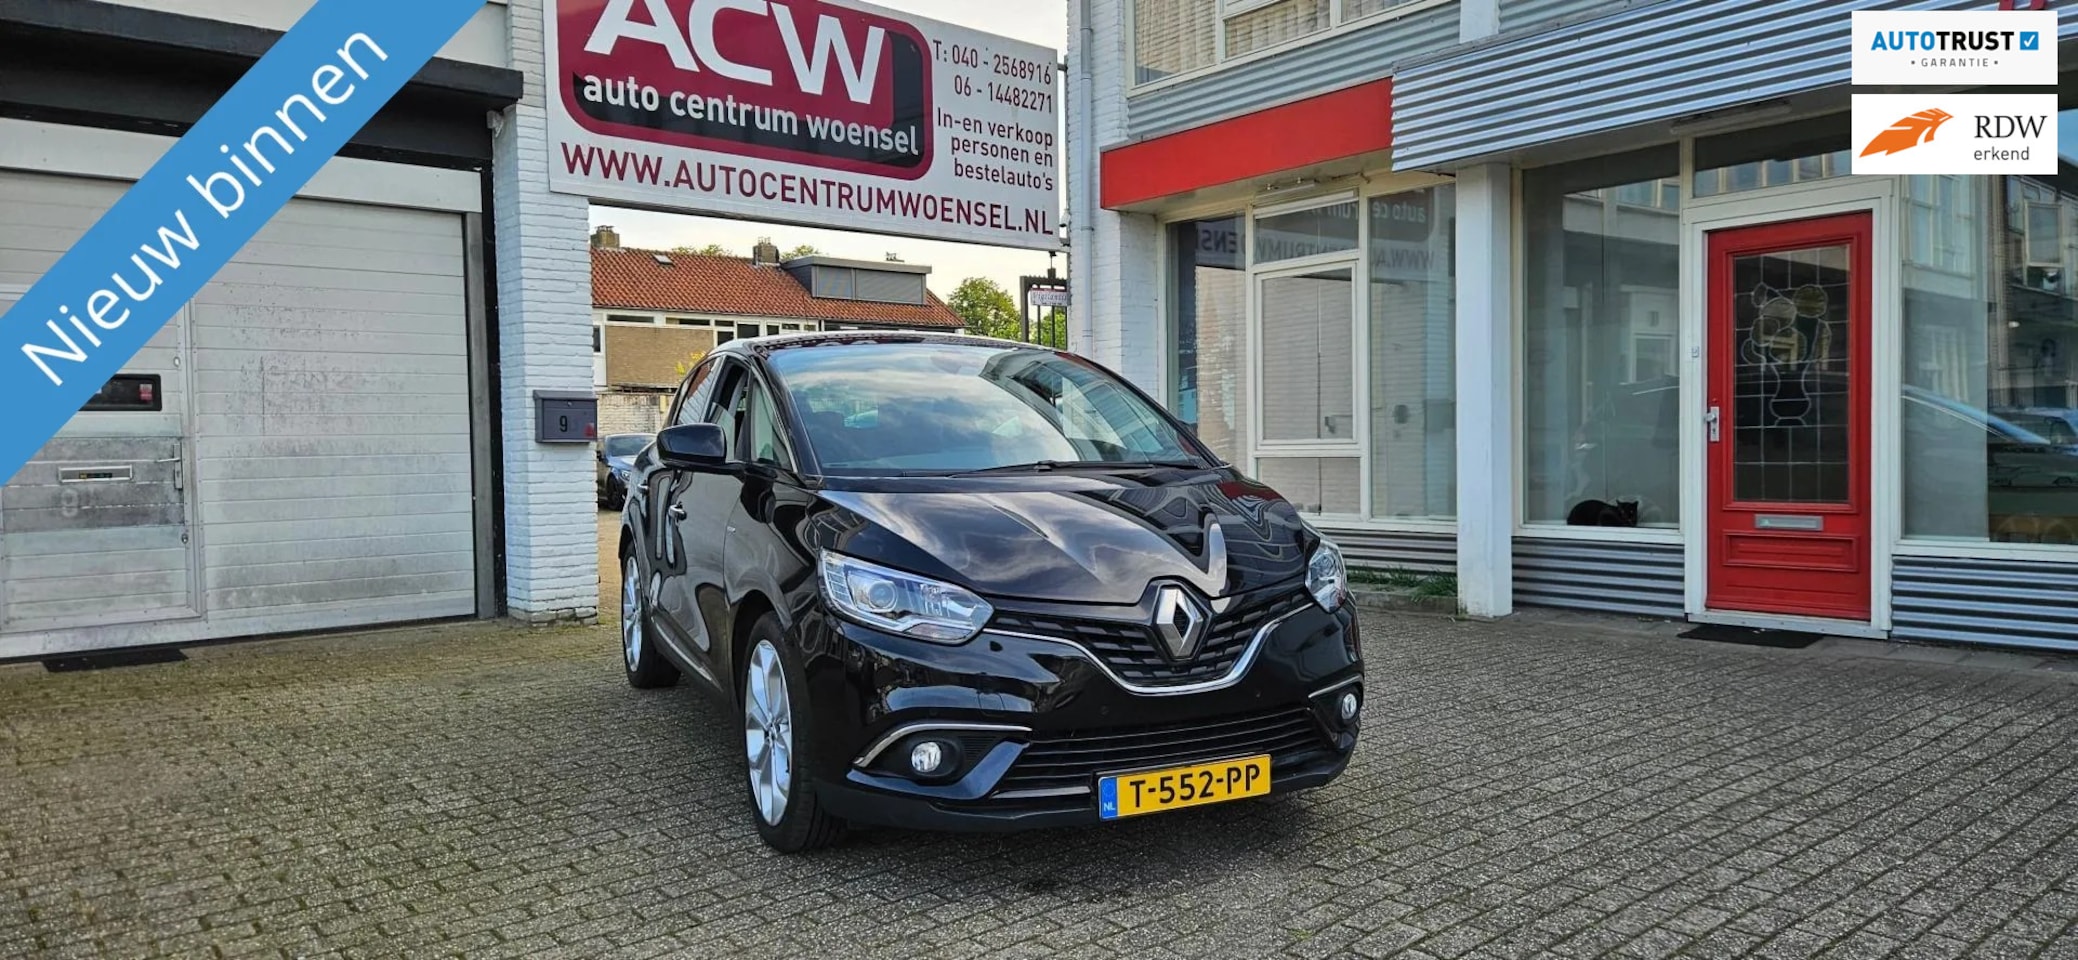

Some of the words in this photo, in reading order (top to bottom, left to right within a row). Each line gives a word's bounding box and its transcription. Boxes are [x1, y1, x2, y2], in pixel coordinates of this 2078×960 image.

[583, 0, 886, 105] ACW
[932, 39, 948, 63] T:
[952, 44, 978, 69] 040
[993, 53, 1052, 85] 2568916
[583, 74, 660, 112] auto
[669, 90, 798, 137] centrum
[805, 114, 919, 156] woensel
[954, 74, 972, 97] 06
[987, 81, 1052, 113] 14482271
[937, 107, 983, 134] In-en
[987, 122, 1053, 151] verkoop
[951, 136, 1029, 163] personen
[1034, 151, 1053, 168] en
[954, 157, 1053, 191] bestelauto's
[560, 141, 1054, 236] WWW.AUTOCENTRUMWOENSEL.NL
[559, 415, 568, 433] 9
[1103, 802, 1116, 811] NL
[1129, 763, 1261, 808] T-552-PP
